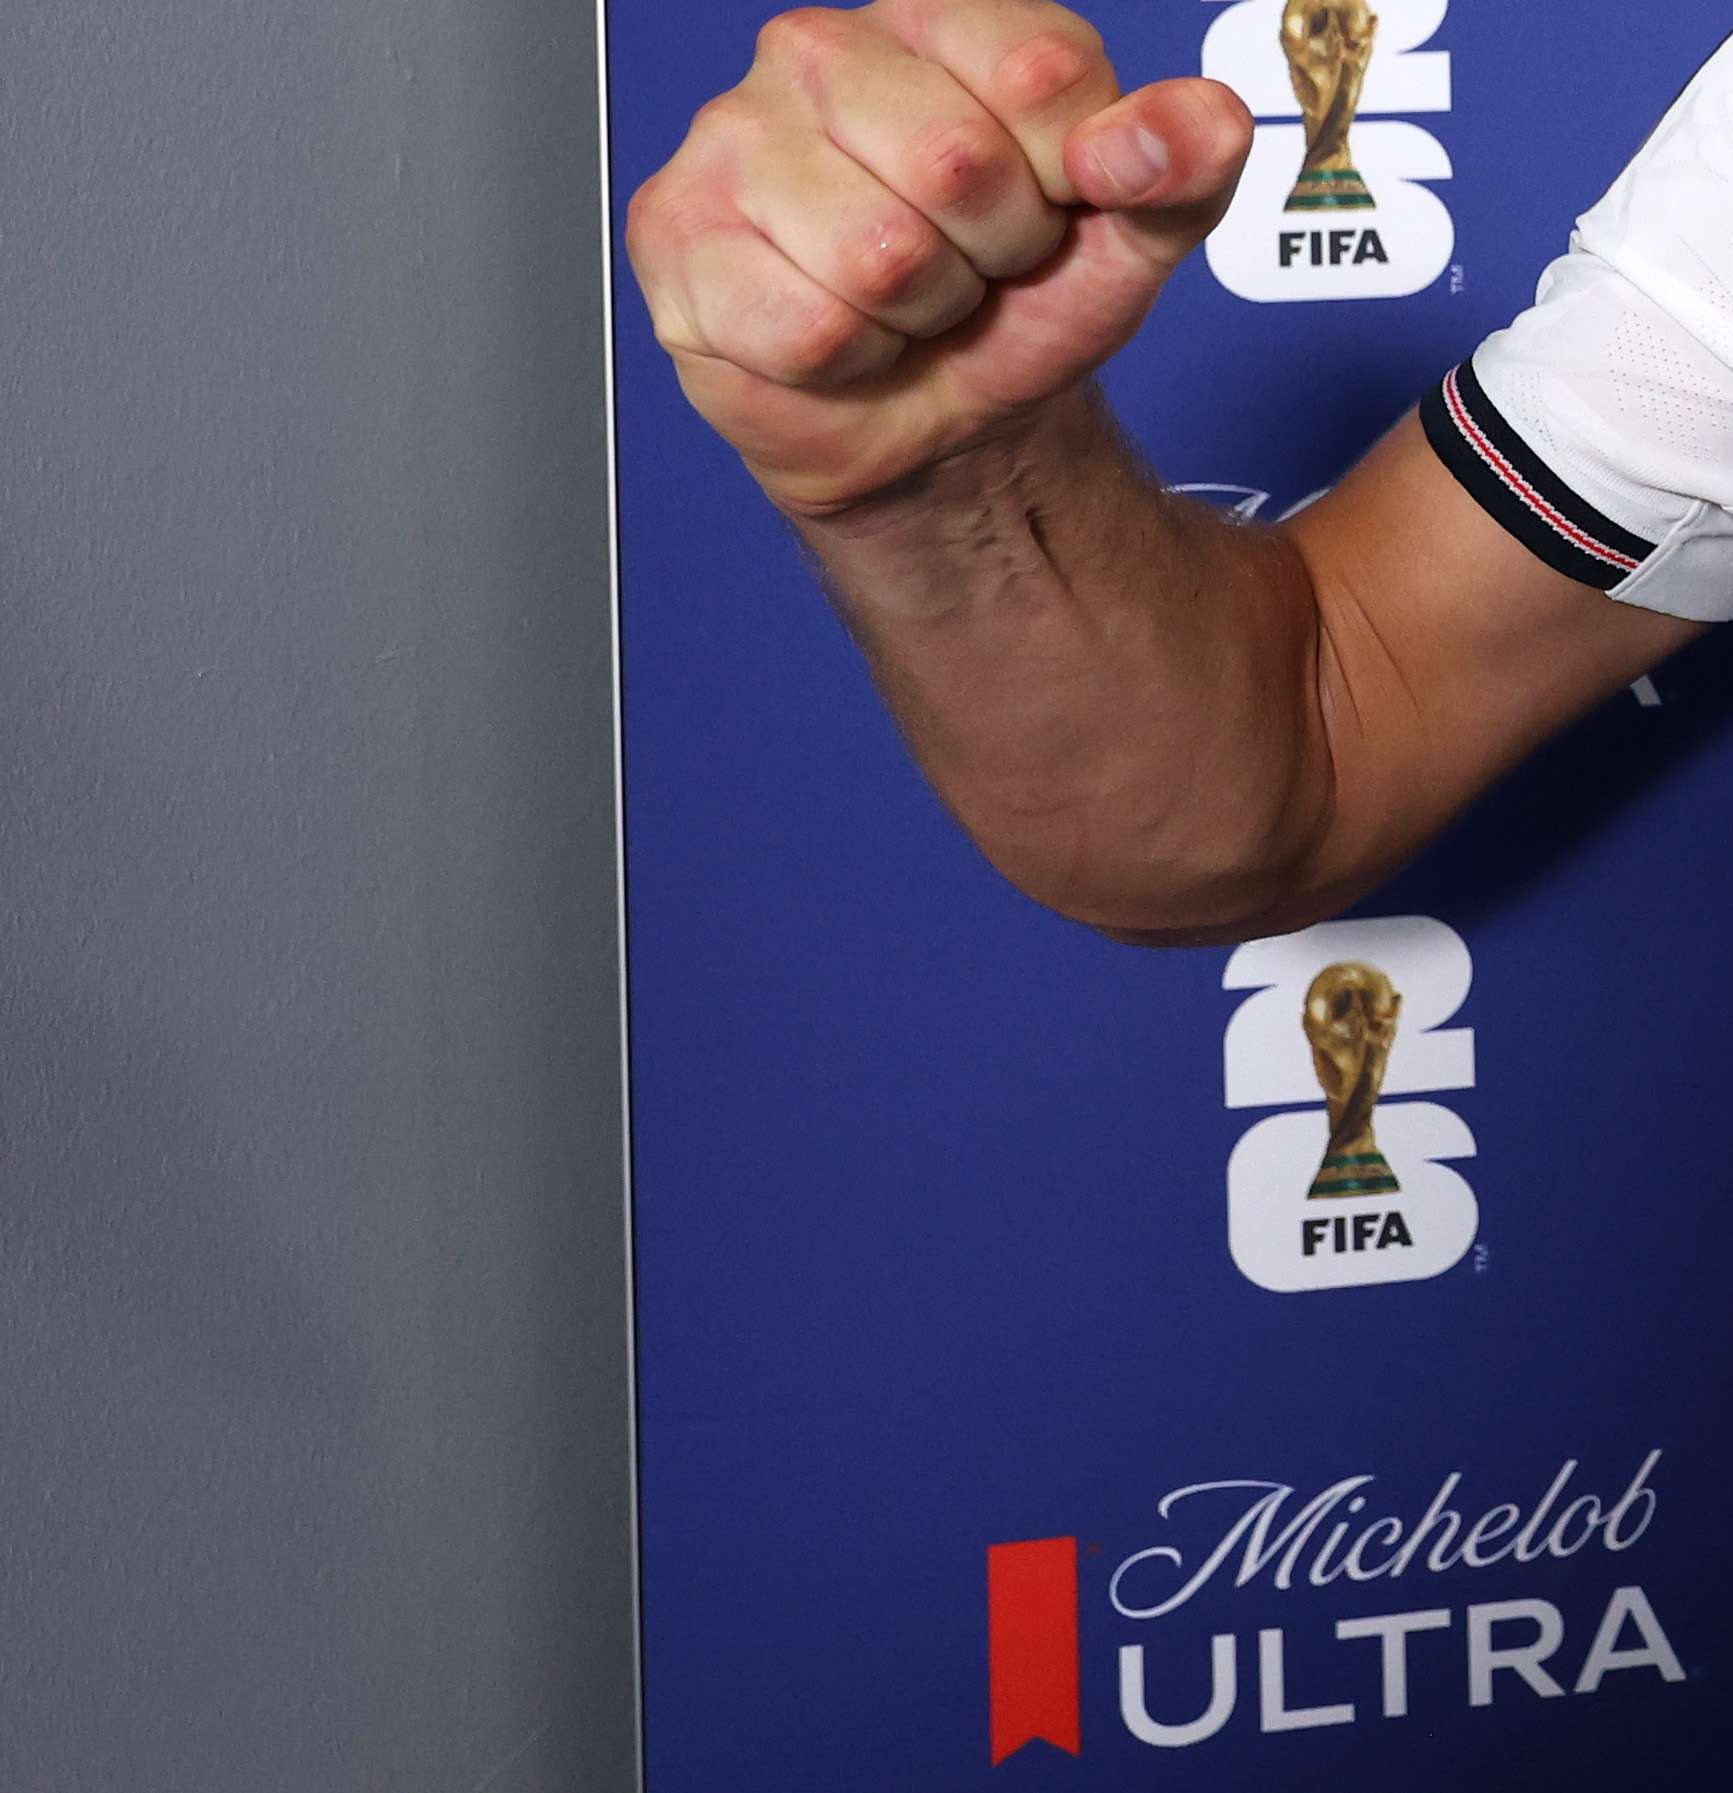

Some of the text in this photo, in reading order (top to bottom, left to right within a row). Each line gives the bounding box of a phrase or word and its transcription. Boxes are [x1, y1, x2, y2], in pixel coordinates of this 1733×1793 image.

[1280, 230, 1388, 267] FIFA
[1303, 1212, 1412, 1256] FIFA
[1109, 1448, 1661, 1620] Michelob
[1116, 1585, 1685, 1748] ULTRA
